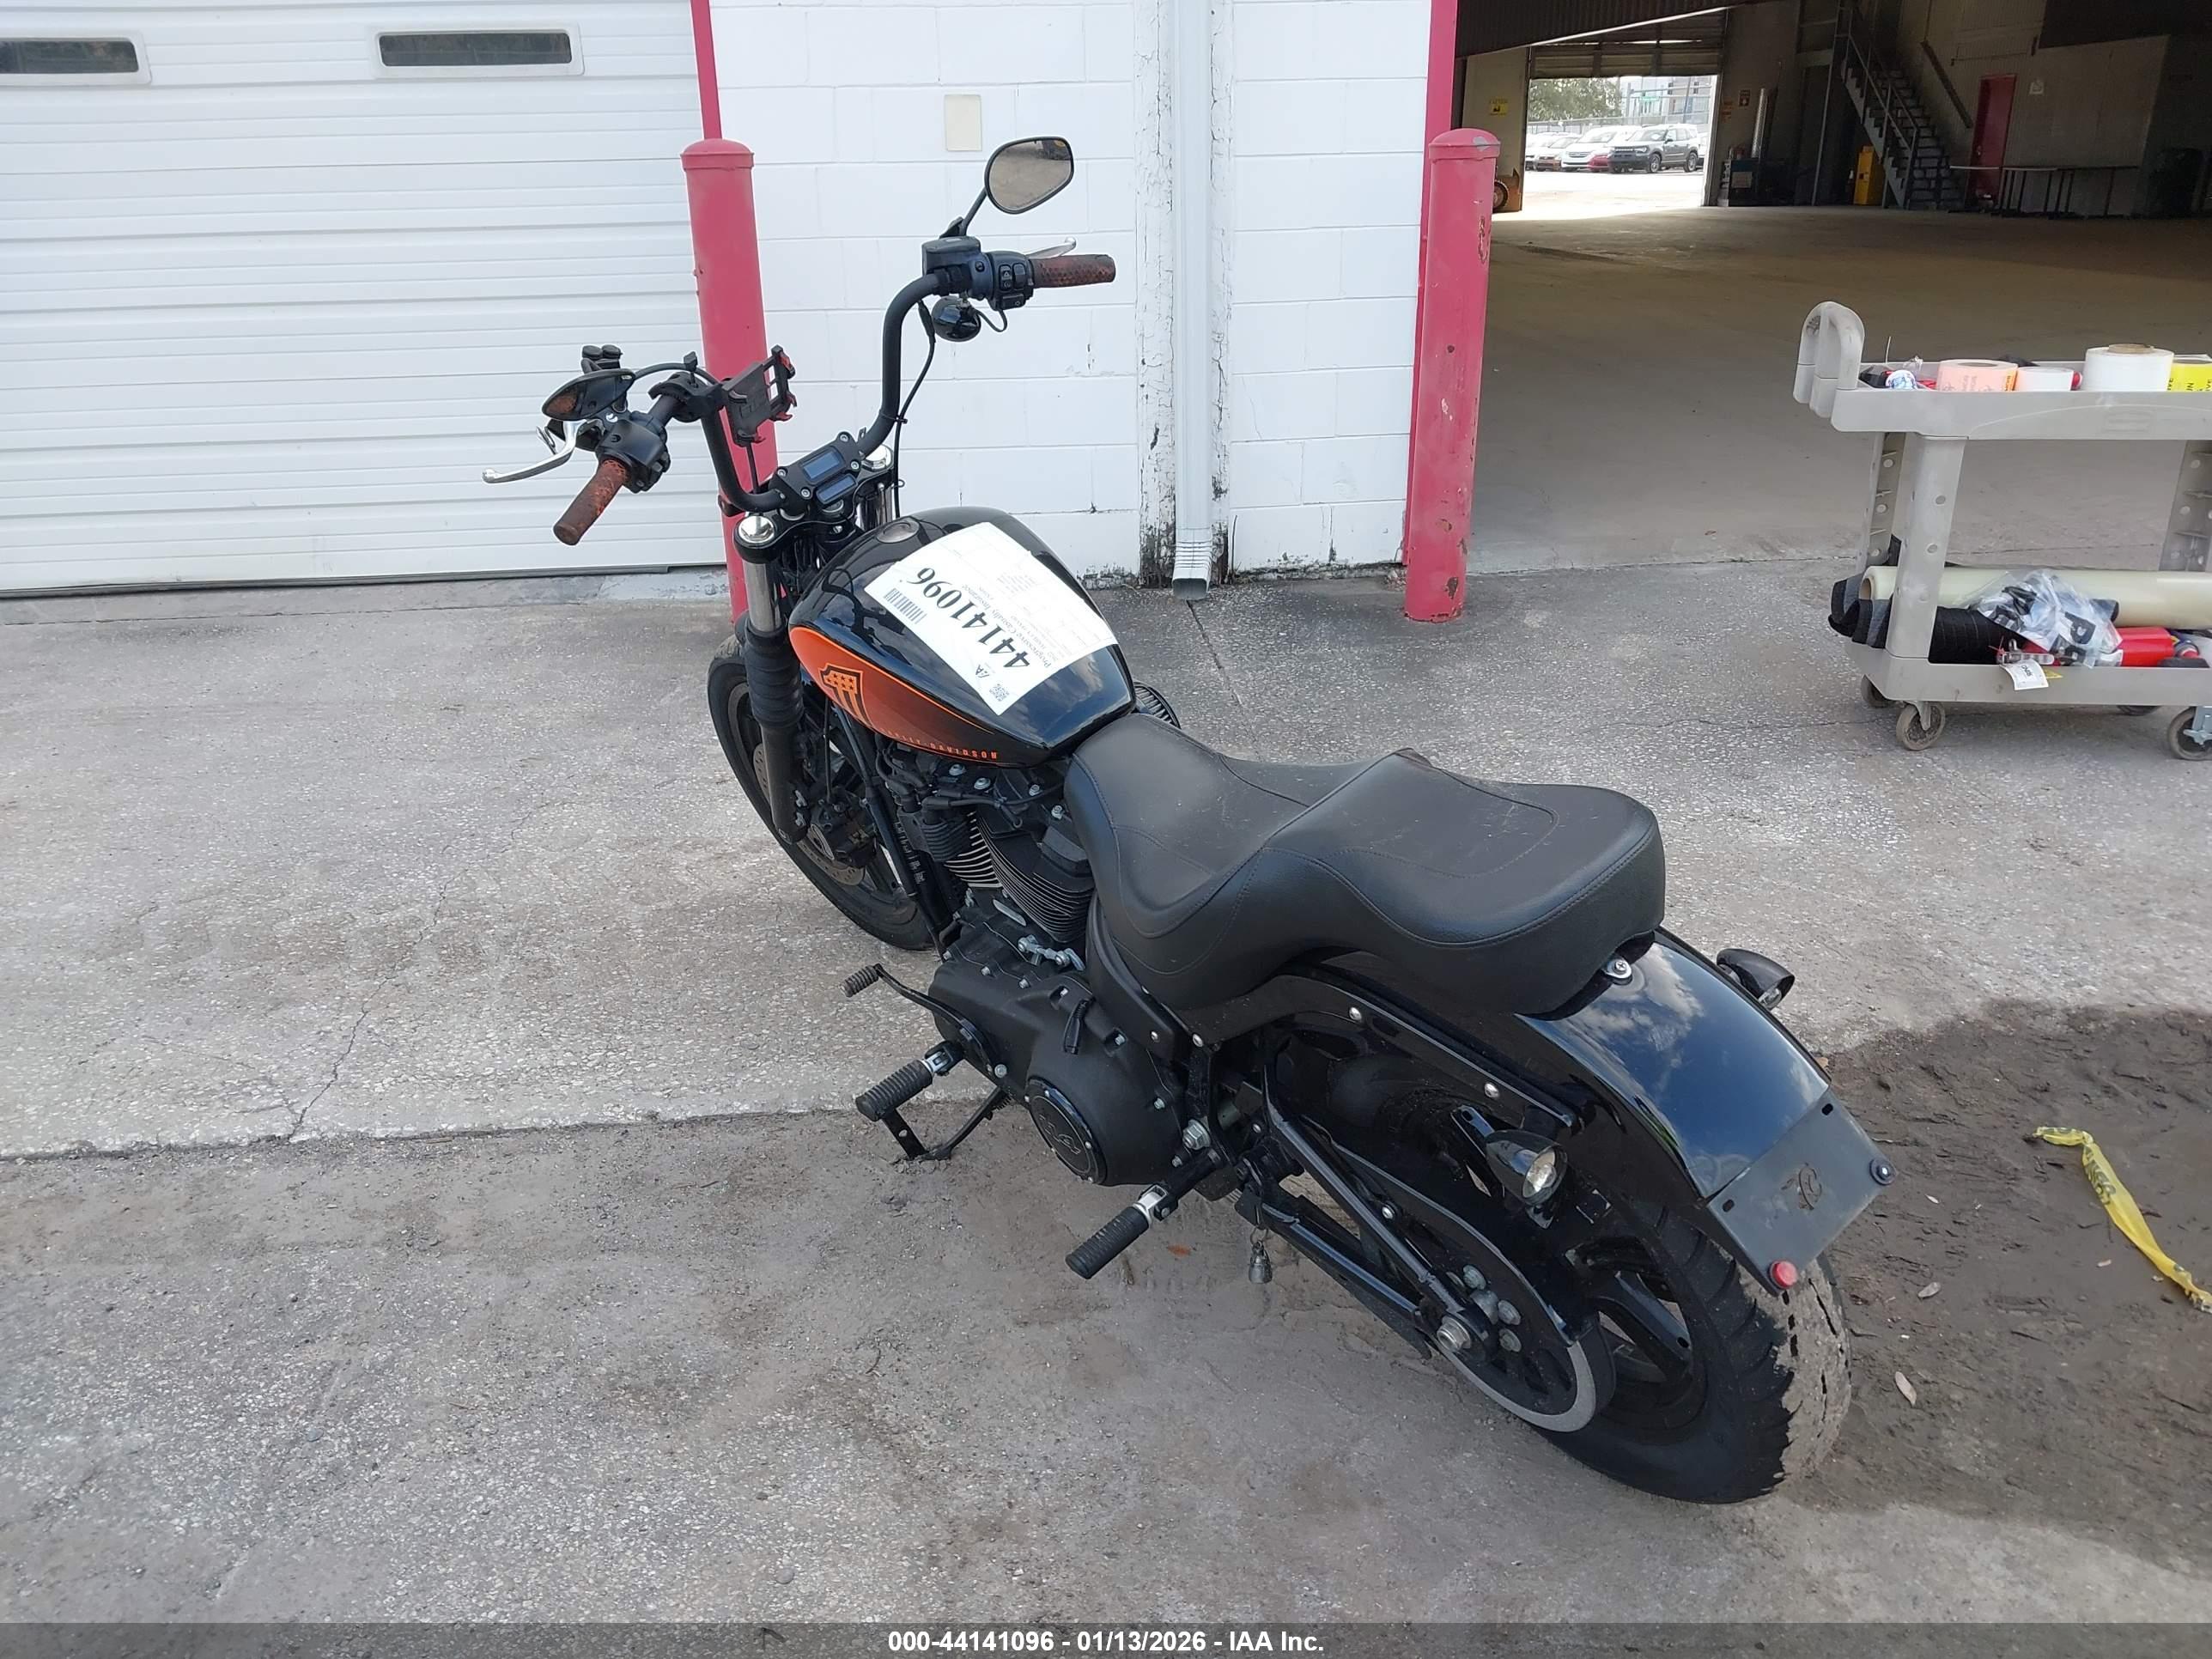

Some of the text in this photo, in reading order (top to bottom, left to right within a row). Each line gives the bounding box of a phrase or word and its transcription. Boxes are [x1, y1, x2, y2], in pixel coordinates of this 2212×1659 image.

[959, 583, 992, 611] Insurance
[906, 566, 1032, 670] 44141096
[1012, 632, 1053, 668] Progressive
